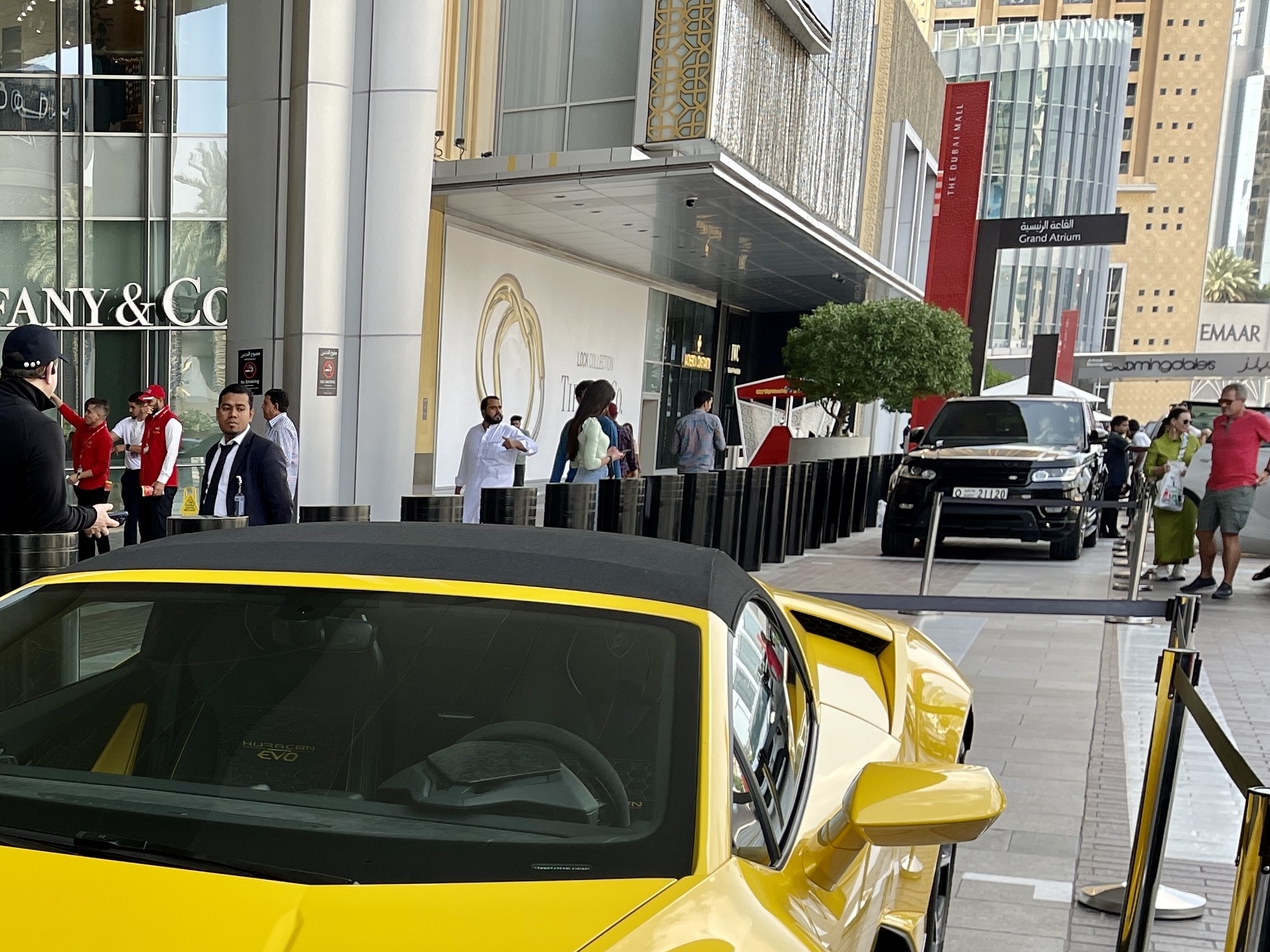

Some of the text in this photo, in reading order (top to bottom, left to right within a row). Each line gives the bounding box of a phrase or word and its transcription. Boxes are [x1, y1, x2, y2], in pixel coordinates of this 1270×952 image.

[947, 103, 965, 196] THE DUBAI MALL
[1020, 218, 1075, 234] القاعة الرئيسية
[1018, 231, 1082, 244] Grand Atrium
[1200, 323, 1261, 342] EMAAR
[977, 488, 1006, 500] 21120
[256, 750, 299, 762] EVO
